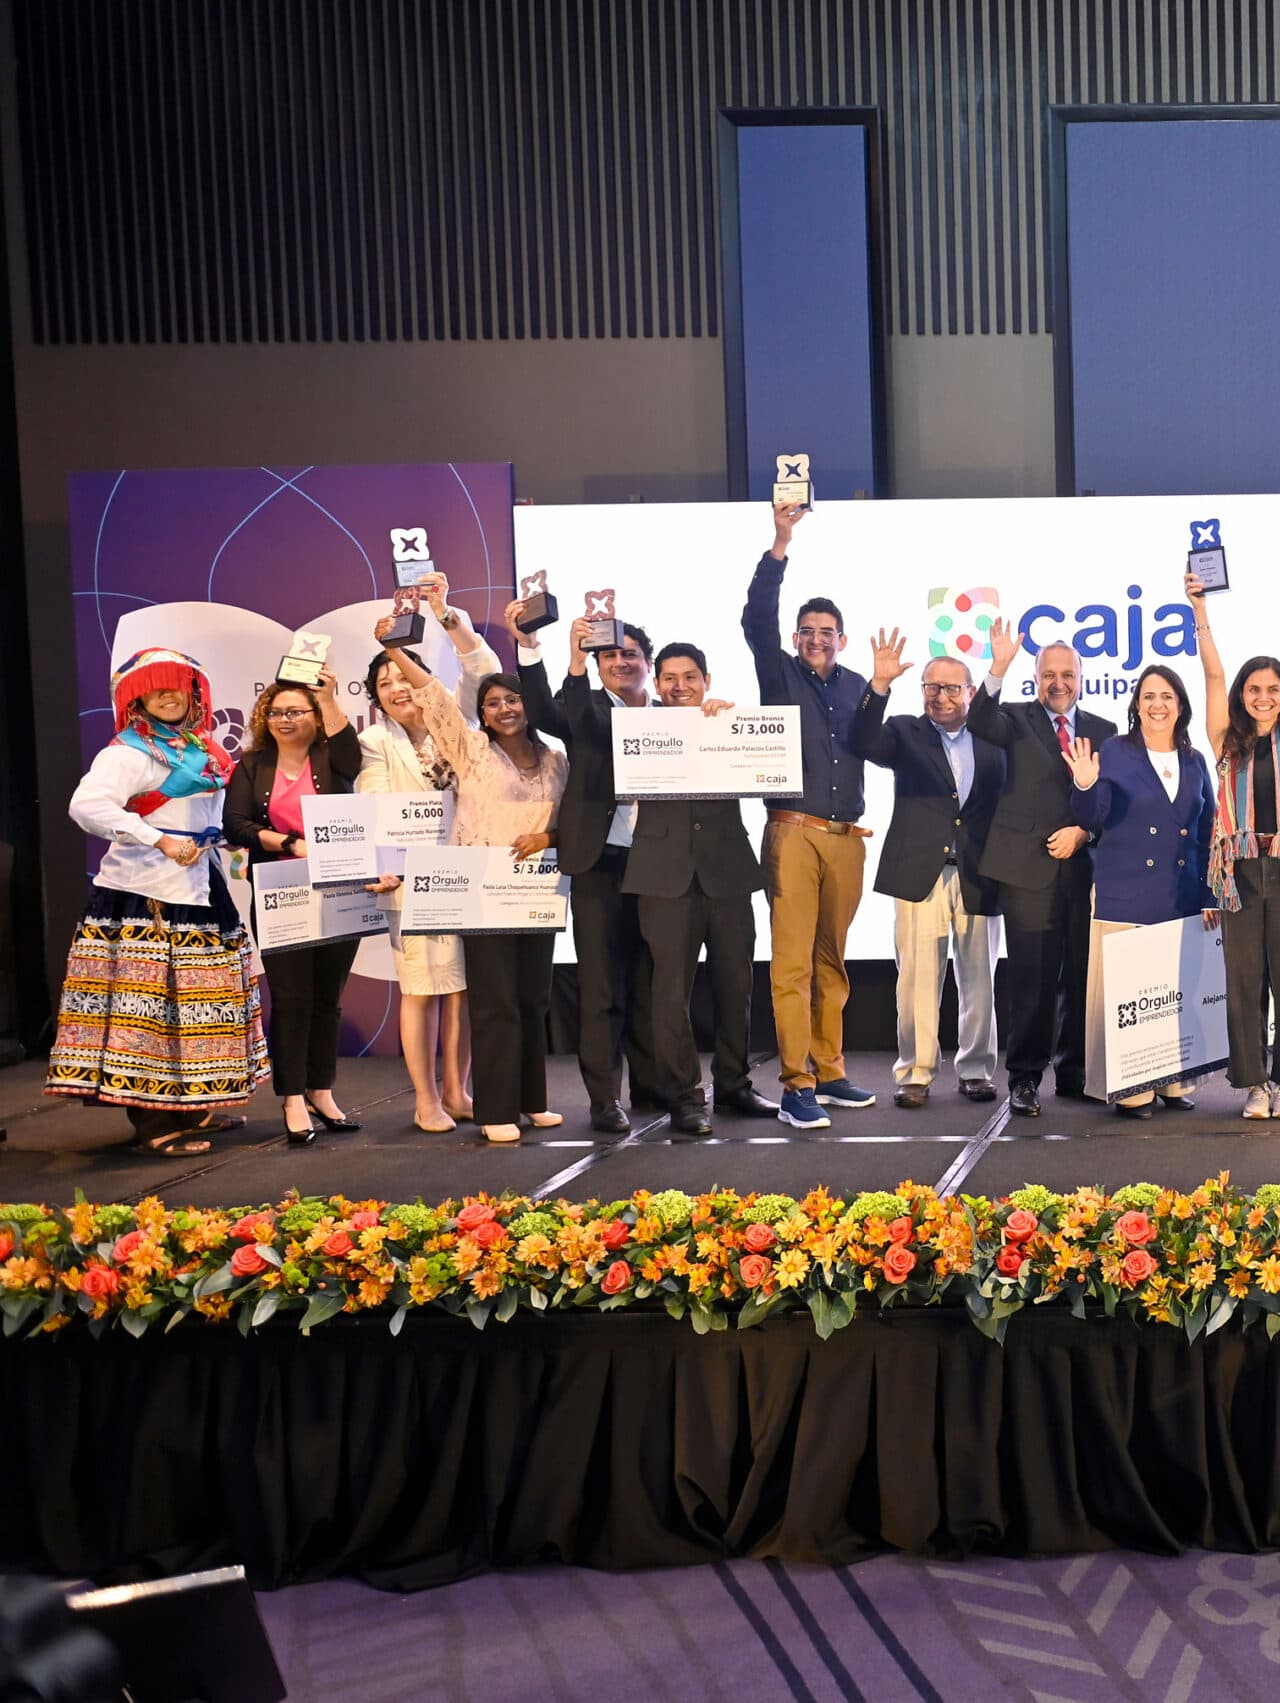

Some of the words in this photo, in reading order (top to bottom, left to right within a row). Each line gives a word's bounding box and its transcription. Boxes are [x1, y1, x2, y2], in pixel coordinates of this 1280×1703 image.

[1018, 584, 1198, 671] caja
[254, 681, 362, 696] PIO
[731, 723, 744, 735] S/
[747, 723, 785, 736] 3,000
[641, 737, 684, 749] Orgullo
[766, 774, 788, 785] caja
[401, 808, 412, 819] S/
[414, 807, 444, 819] 6,000
[330, 824, 365, 836] Orgullo
[513, 863, 525, 875] S/
[527, 864, 560, 875] 3,000
[431, 875, 470, 887] Orgullo
[278, 888, 310, 901] Orgullo
[369, 911, 385, 923] caja
[537, 910, 556, 920] caja
[1138, 983, 1169, 995] PREMIO
[1138, 990, 1183, 1011] Orgullo
[1139, 1006, 1184, 1024] EMPRENDEDOR
